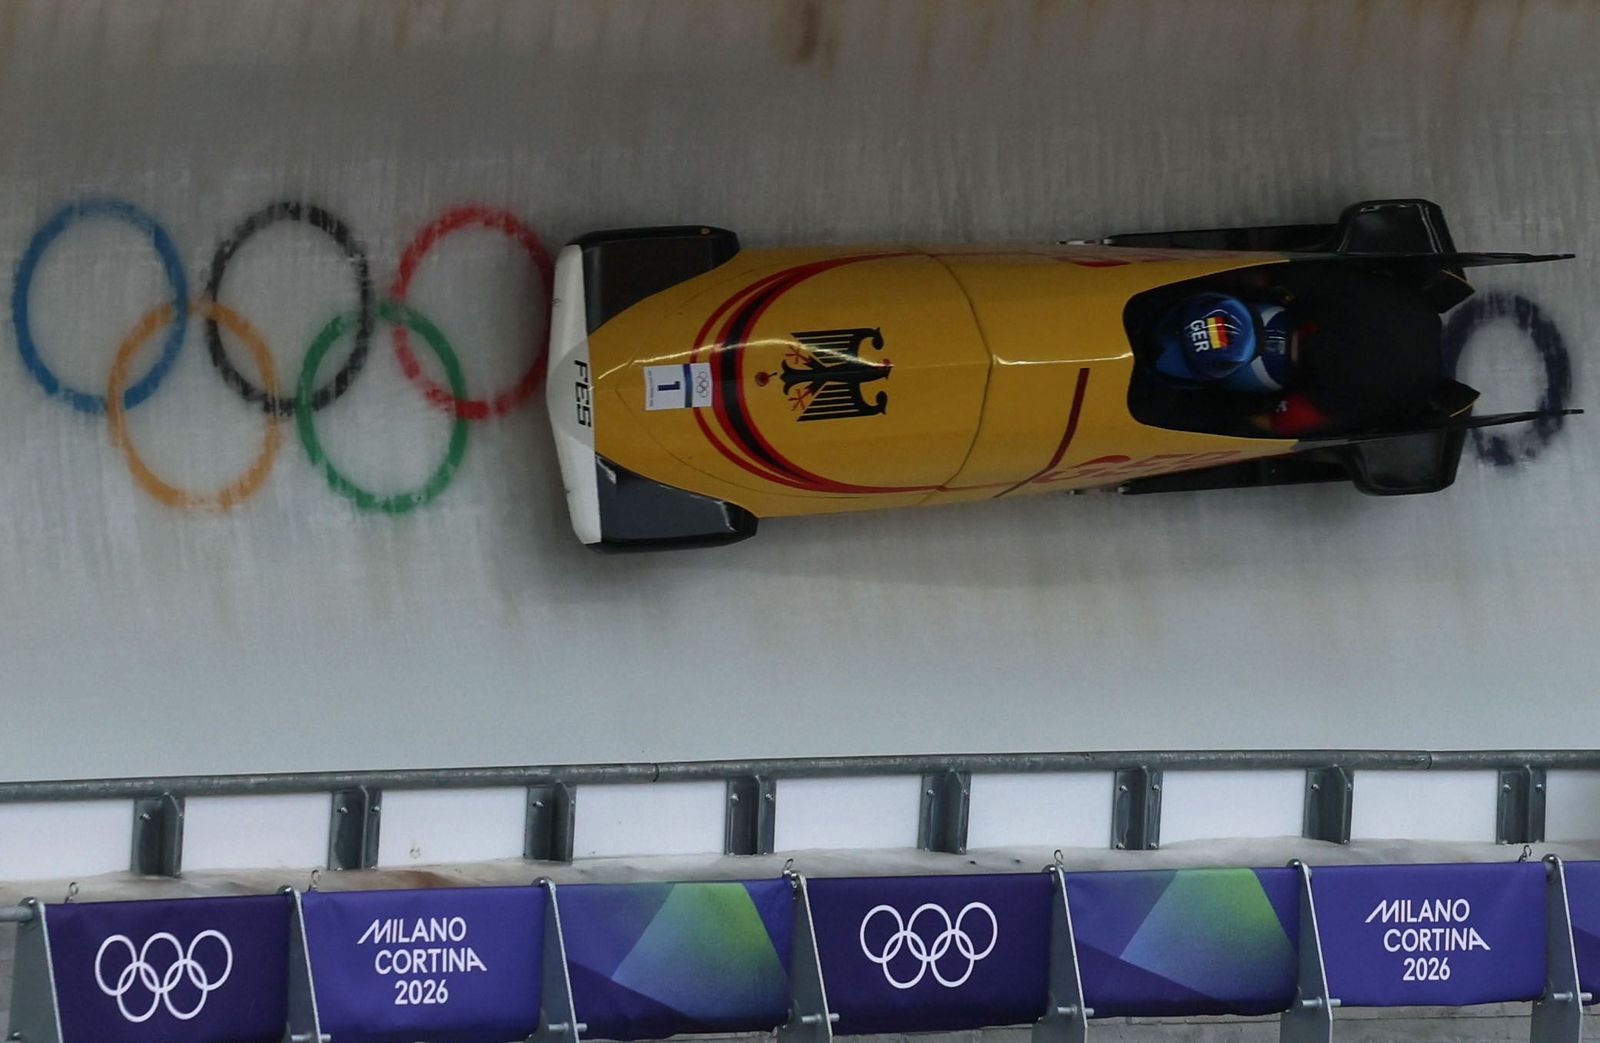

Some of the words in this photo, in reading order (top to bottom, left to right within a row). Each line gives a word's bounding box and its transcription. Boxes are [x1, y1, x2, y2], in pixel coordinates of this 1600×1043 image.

[1190, 319, 1210, 352] GER
[574, 360, 592, 428] FES
[657, 381, 681, 392] 1
[1364, 899, 1470, 923] MILANO
[357, 917, 467, 945] MILANO
[1383, 927, 1491, 953] CORTINA
[374, 948, 488, 975] CORTINA
[1402, 957, 1451, 981] 2026
[394, 979, 449, 1005] 2026
